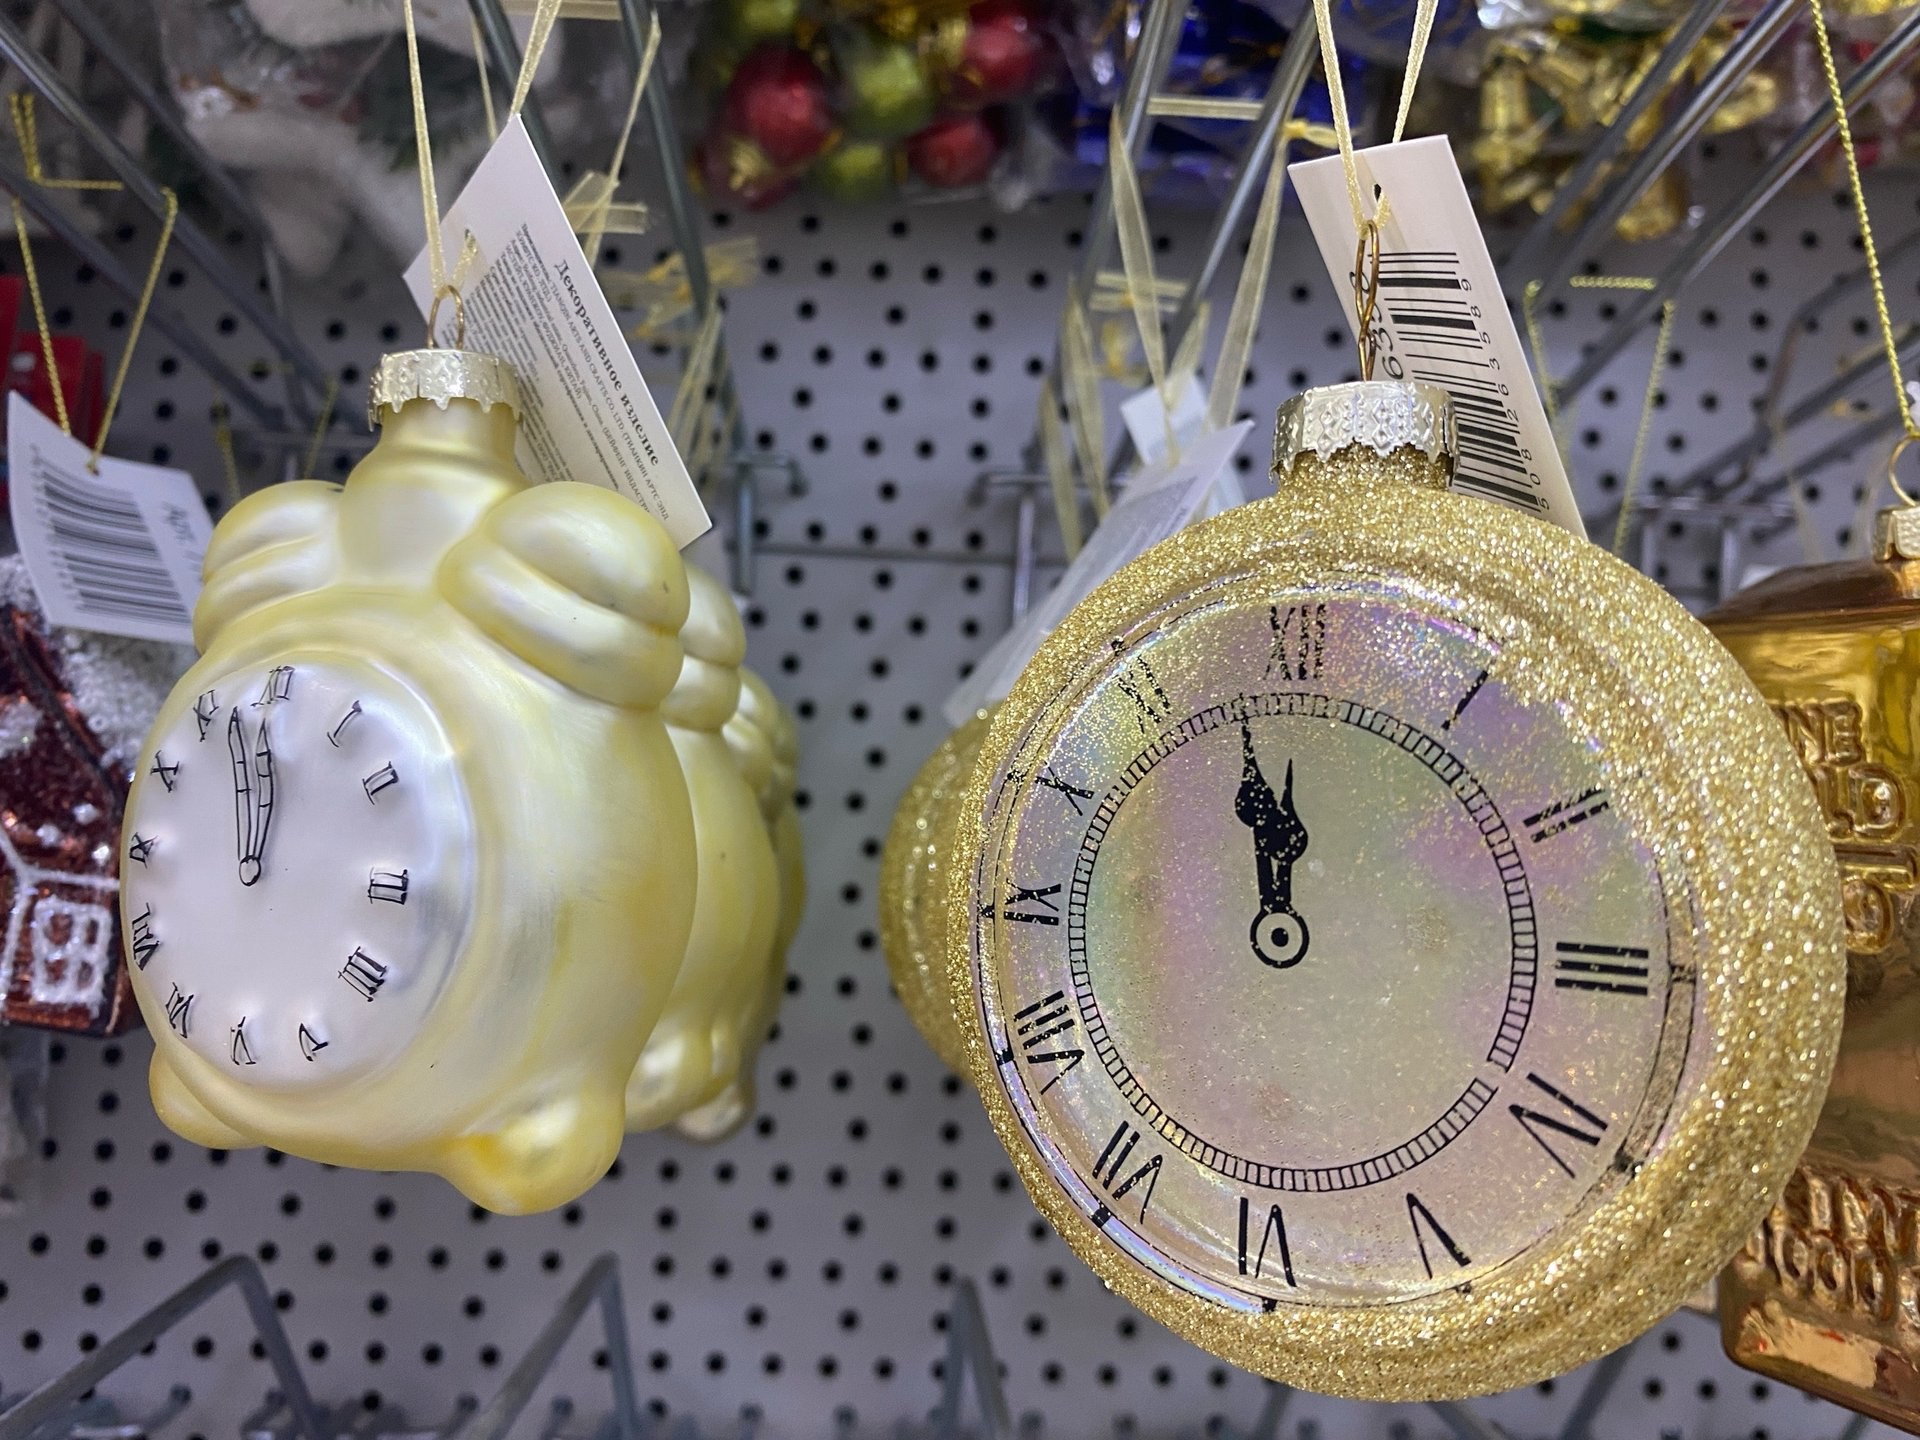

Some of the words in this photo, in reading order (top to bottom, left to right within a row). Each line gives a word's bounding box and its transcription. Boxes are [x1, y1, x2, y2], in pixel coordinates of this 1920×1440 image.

[554, 260, 622, 391] Декоративное
[620, 394, 658, 465] изделие
[1263, 604, 1328, 681] XII
[1117, 655, 1172, 734] XI
[1441, 671, 1488, 731] I
[327, 700, 362, 748] I
[150, 750, 180, 793] X
[362, 761, 398, 805] II
[1035, 759, 1094, 816] X
[1523, 787, 1610, 843] II
[368, 866, 409, 905] III
[1003, 878, 1062, 926] IX
[1555, 942, 1649, 996] III
[299, 1023, 329, 1062] V
[1014, 990, 1085, 1095] VIII
[1509, 1072, 1608, 1178] IV
[1093, 1120, 1162, 1224] VII
[1239, 1196, 1297, 1287] VI
[1406, 1193, 1471, 1279] V
